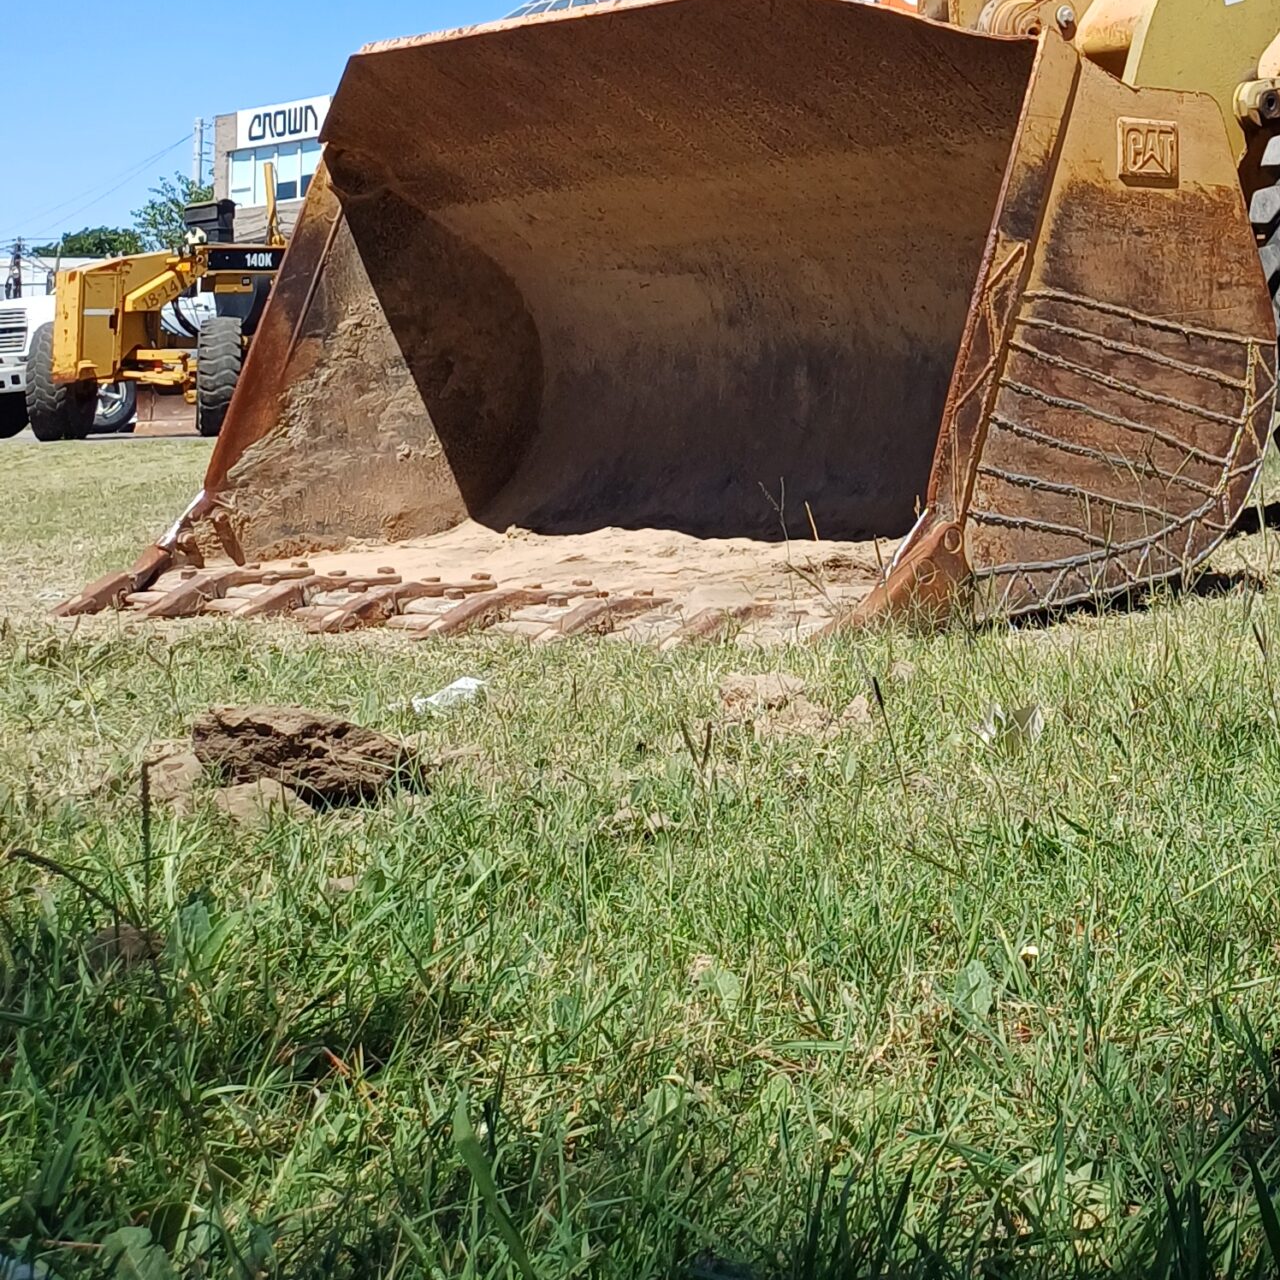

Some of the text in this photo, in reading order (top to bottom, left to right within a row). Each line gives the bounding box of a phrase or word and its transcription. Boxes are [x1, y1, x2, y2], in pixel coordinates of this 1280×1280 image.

[248, 104, 318, 141] CROWN
[1126, 128, 1174, 176] CAT
[245, 252, 273, 268] 140K
[142, 279, 179, 310] 18-14
